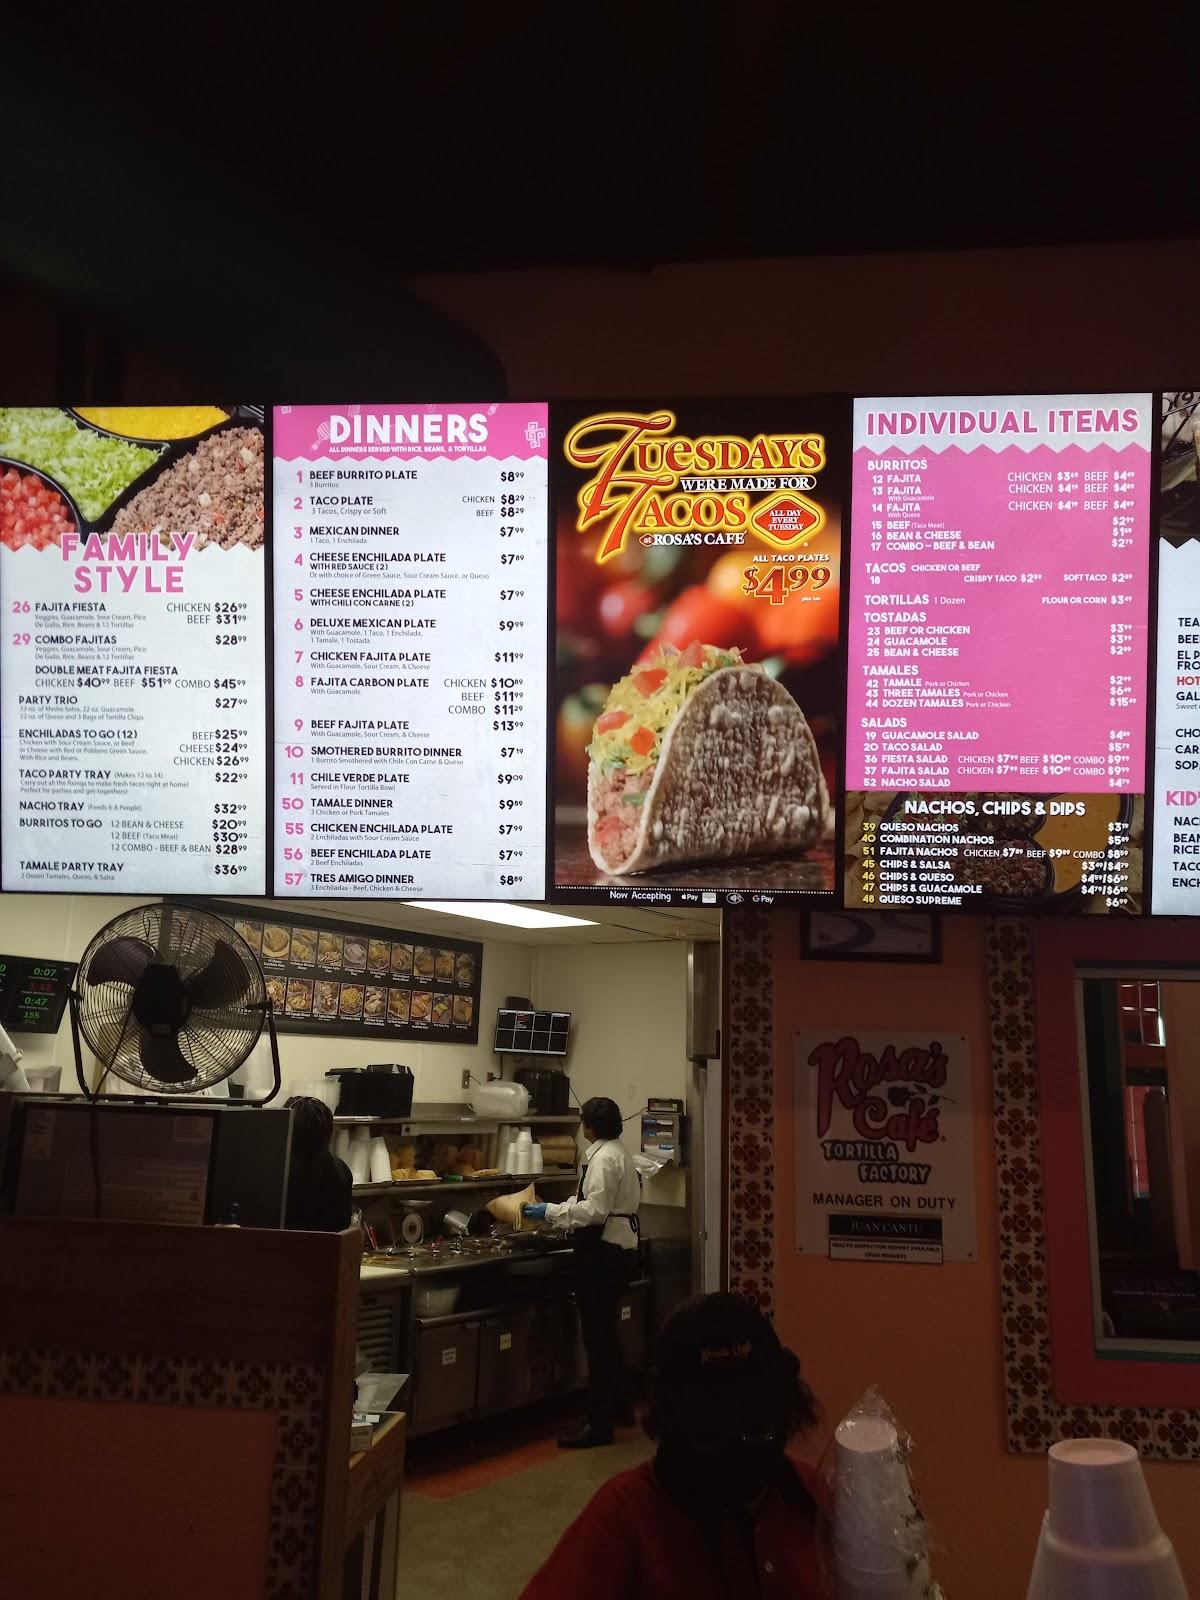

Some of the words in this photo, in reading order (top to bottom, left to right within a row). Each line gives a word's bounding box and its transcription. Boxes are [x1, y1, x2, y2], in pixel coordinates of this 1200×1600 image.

[866, 410, 1038, 436] INDIVIDUAL
[1048, 408, 1139, 434] ITEMS
[329, 413, 489, 444] DINNERS
[454, 445, 487, 453] TORTILLAS
[867, 460, 928, 471] BURRITOS
[296, 471, 303, 484] 1
[309, 470, 335, 480] BEEF
[337, 470, 383, 480] BURRITO
[385, 470, 418, 480] PLATE
[872, 475, 883, 484] 12
[887, 474, 921, 483] FAJITA
[1007, 472, 1052, 482] CHICKEN
[681, 477, 727, 491] WERE
[730, 477, 777, 490] MADE
[779, 477, 810, 489] FOR
[293, 497, 303, 510] 2
[310, 496, 340, 506] TACO
[341, 496, 374, 506] PLATE
[462, 495, 495, 503] CHICKEN
[311, 507, 316, 515] 3
[317, 507, 339, 516] Tacos,
[340, 507, 362, 516] Crispy
[372, 507, 387, 515] Soft
[769, 510, 785, 518] ALL
[786, 509, 802, 517] DAY
[580, 475, 747, 559] TACOS
[771, 516, 798, 524] EVERY
[309, 526, 359, 536] MEXICAN
[360, 526, 400, 536] DINNER
[767, 523, 805, 531] TUESDAY
[653, 533, 702, 546] ROSA'S
[871, 531, 882, 540] 16
[886, 531, 913, 540] BEAN
[915, 531, 922, 540] &
[924, 530, 962, 540] CHEESE
[59, 531, 196, 562] FAMILY
[309, 553, 350, 562] CHEESE
[352, 553, 412, 562] ENCHILADA
[414, 553, 447, 562] PLATE
[752, 554, 769, 563] ALL
[771, 554, 796, 563] TACO
[797, 554, 830, 562] PLATES
[865, 563, 906, 574] TACOS
[911, 564, 947, 572] CHICKEN
[960, 563, 981, 571] BEEF
[73, 565, 185, 593] STYLE
[963, 574, 993, 583] CRISPY
[994, 574, 1017, 583] TACO
[864, 595, 929, 605] TORTILLAS
[939, 596, 965, 605] Dozen
[1041, 596, 1068, 604] FLOUR
[1070, 596, 1082, 604] OR
[1083, 596, 1107, 604] CORN
[12, 601, 31, 614] 26
[35, 603, 71, 612] FAJITA
[72, 603, 106, 612] FIESTA
[166, 603, 211, 613] CHICKEN
[864, 612, 927, 623] TOSTADAS
[12, 634, 31, 645] 29
[35, 635, 74, 644] COMBO
[75, 635, 117, 644] FAJITAS
[1177, 651, 1191, 660] EL
[35, 666, 75, 675] DOUBLE
[76, 666, 105, 675] MEAT
[106, 666, 142, 675] FAJITA
[143, 667, 178, 675] FIESTA
[863, 665, 919, 676] TAMALES
[311, 678, 347, 687] FAJITA
[349, 678, 395, 687] CARBON
[397, 678, 429, 687] PLATE
[19, 695, 52, 705] PARTY
[53, 695, 78, 705] TRIO
[861, 717, 907, 728] SALADS
[19, 729, 81, 739] ENCHILADAS
[83, 729, 97, 739] TO
[98, 729, 115, 739] GO
[116, 729, 138, 739] (12)
[284, 746, 304, 758] 10
[311, 747, 374, 757] SMOTHERED
[376, 747, 422, 757] BURRITO
[423, 748, 462, 757] DINNER
[19, 769, 47, 779] TACO
[49, 769, 82, 779] PARTY
[84, 770, 112, 779] TRAY
[137, 771, 144, 779] 12
[311, 799, 353, 808] TAMALE
[354, 799, 393, 808] DINNER
[905, 801, 979, 817] NACHOS,
[983, 801, 1031, 815] CHIPS
[1035, 801, 1046, 815] &
[1050, 802, 1085, 816] DIPS
[19, 819, 69, 828] BURRITOS
[71, 819, 84, 828] TO
[86, 819, 103, 828] GO
[110, 820, 120, 829] 12
[121, 820, 144, 829] BEAN
[145, 820, 151, 829] &
[153, 820, 184, 829] CHEESE
[863, 823, 876, 832] 39
[880, 823, 915, 833] QUESO
[917, 823, 959, 832] NACHOS
[20, 861, 60, 871] TAMALE
[61, 862, 95, 871] PARTY
[96, 862, 124, 872] TRAY
[880, 860, 908, 869] CHIPS
[910, 860, 917, 869] &
[919, 860, 951, 870] SALSA
[610, 891, 629, 900] Now
[631, 891, 671, 903] Accepting
[687, 893, 699, 902] Pay
[761, 895, 774, 905] Pay
[33, 967, 57, 977] 0:07
[24, 996, 48, 1006] 0:47
[807, 1036, 949, 1139] Rosa's
[821, 1141, 898, 1161] TORTILLA
[859, 1164, 930, 1183] FACTORY
[812, 1193, 883, 1206] MANAGER
[890, 1196, 911, 1208] ON
[917, 1197, 956, 1209] DUTY
